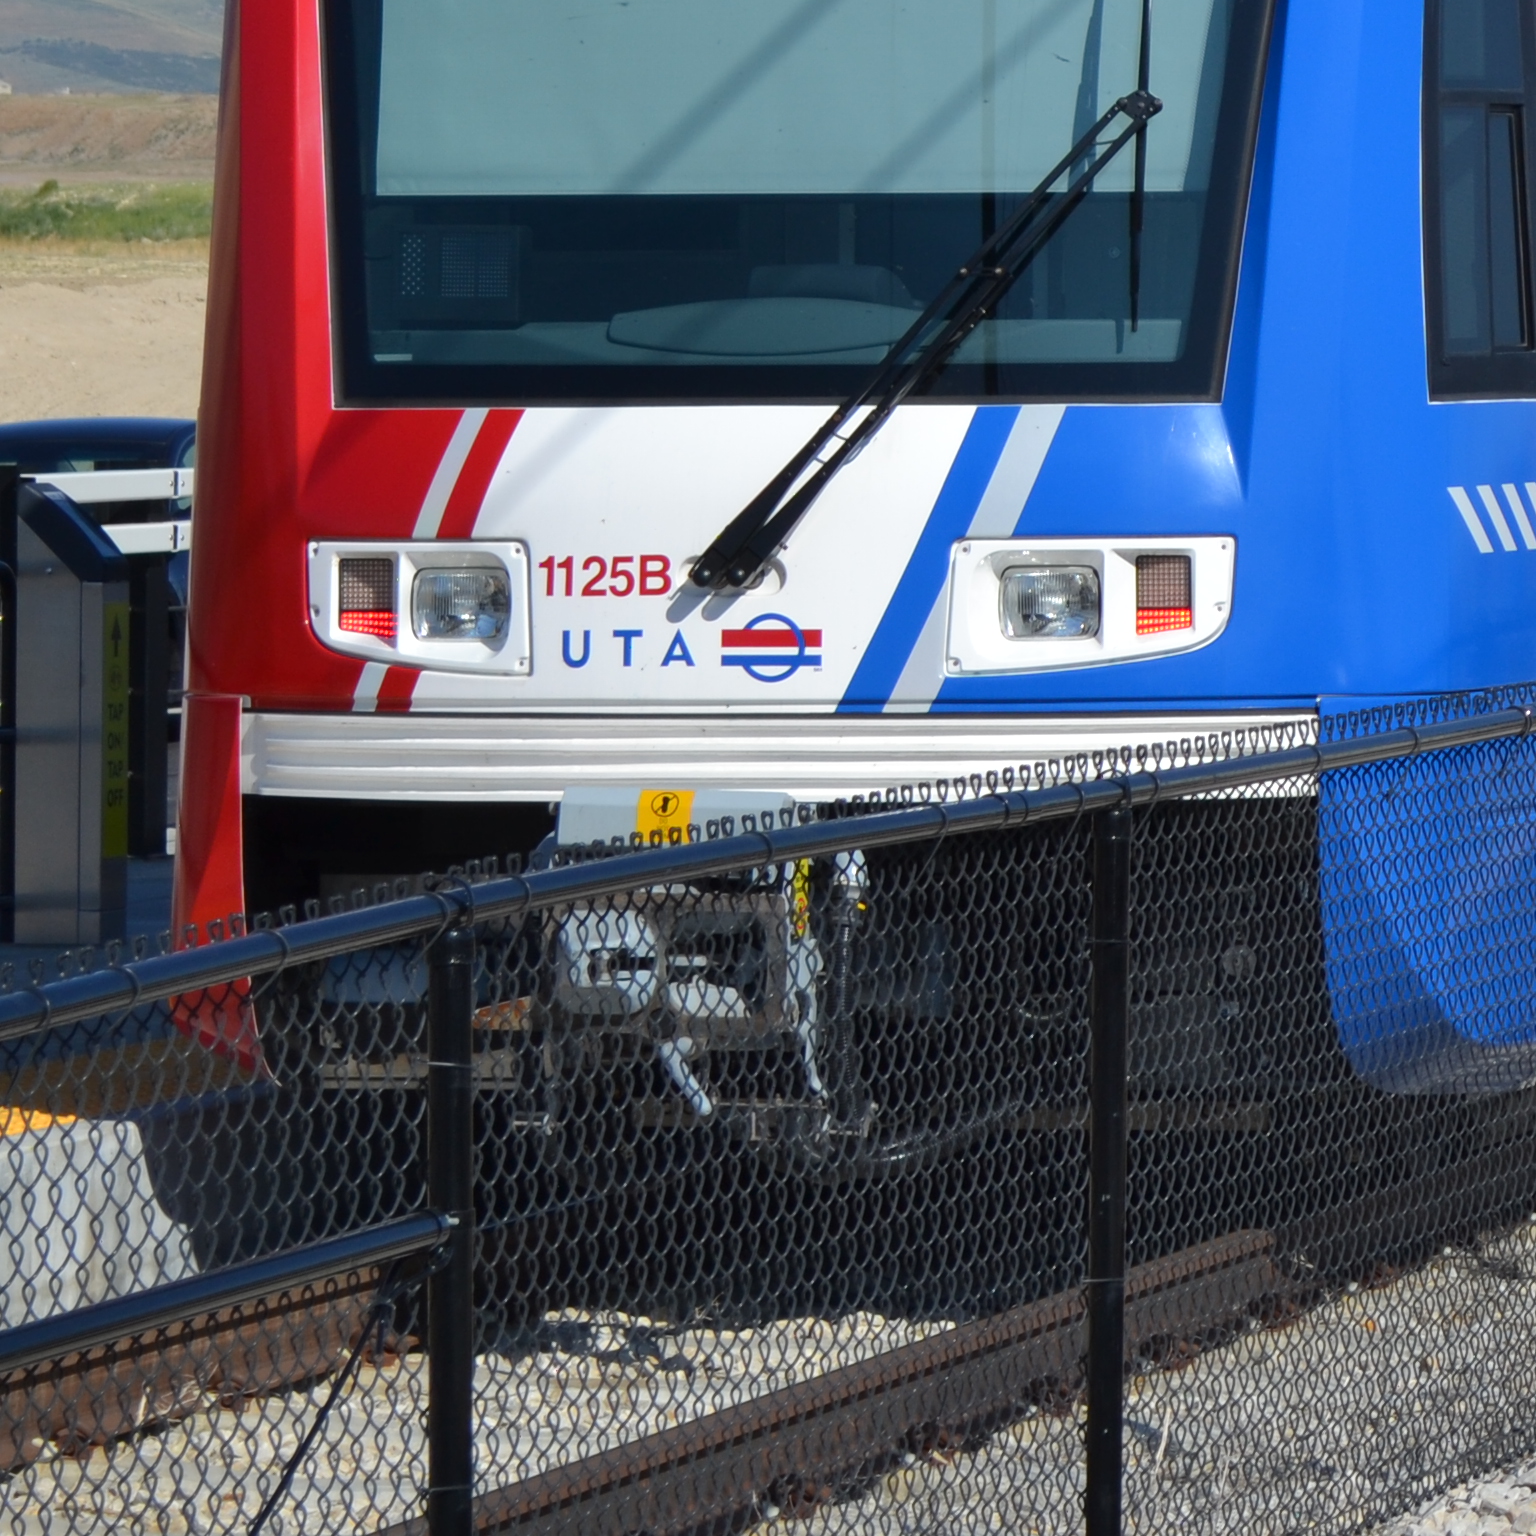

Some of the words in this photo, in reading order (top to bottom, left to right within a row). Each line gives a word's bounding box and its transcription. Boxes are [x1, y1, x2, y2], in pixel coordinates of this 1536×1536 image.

[539, 554, 672, 597] 1125B
[562, 629, 696, 668] UTA
[107, 703, 124, 722] TAP
[107, 732, 122, 751] ON
[107, 760, 124, 779] TAP
[107, 789, 124, 808] OFF
